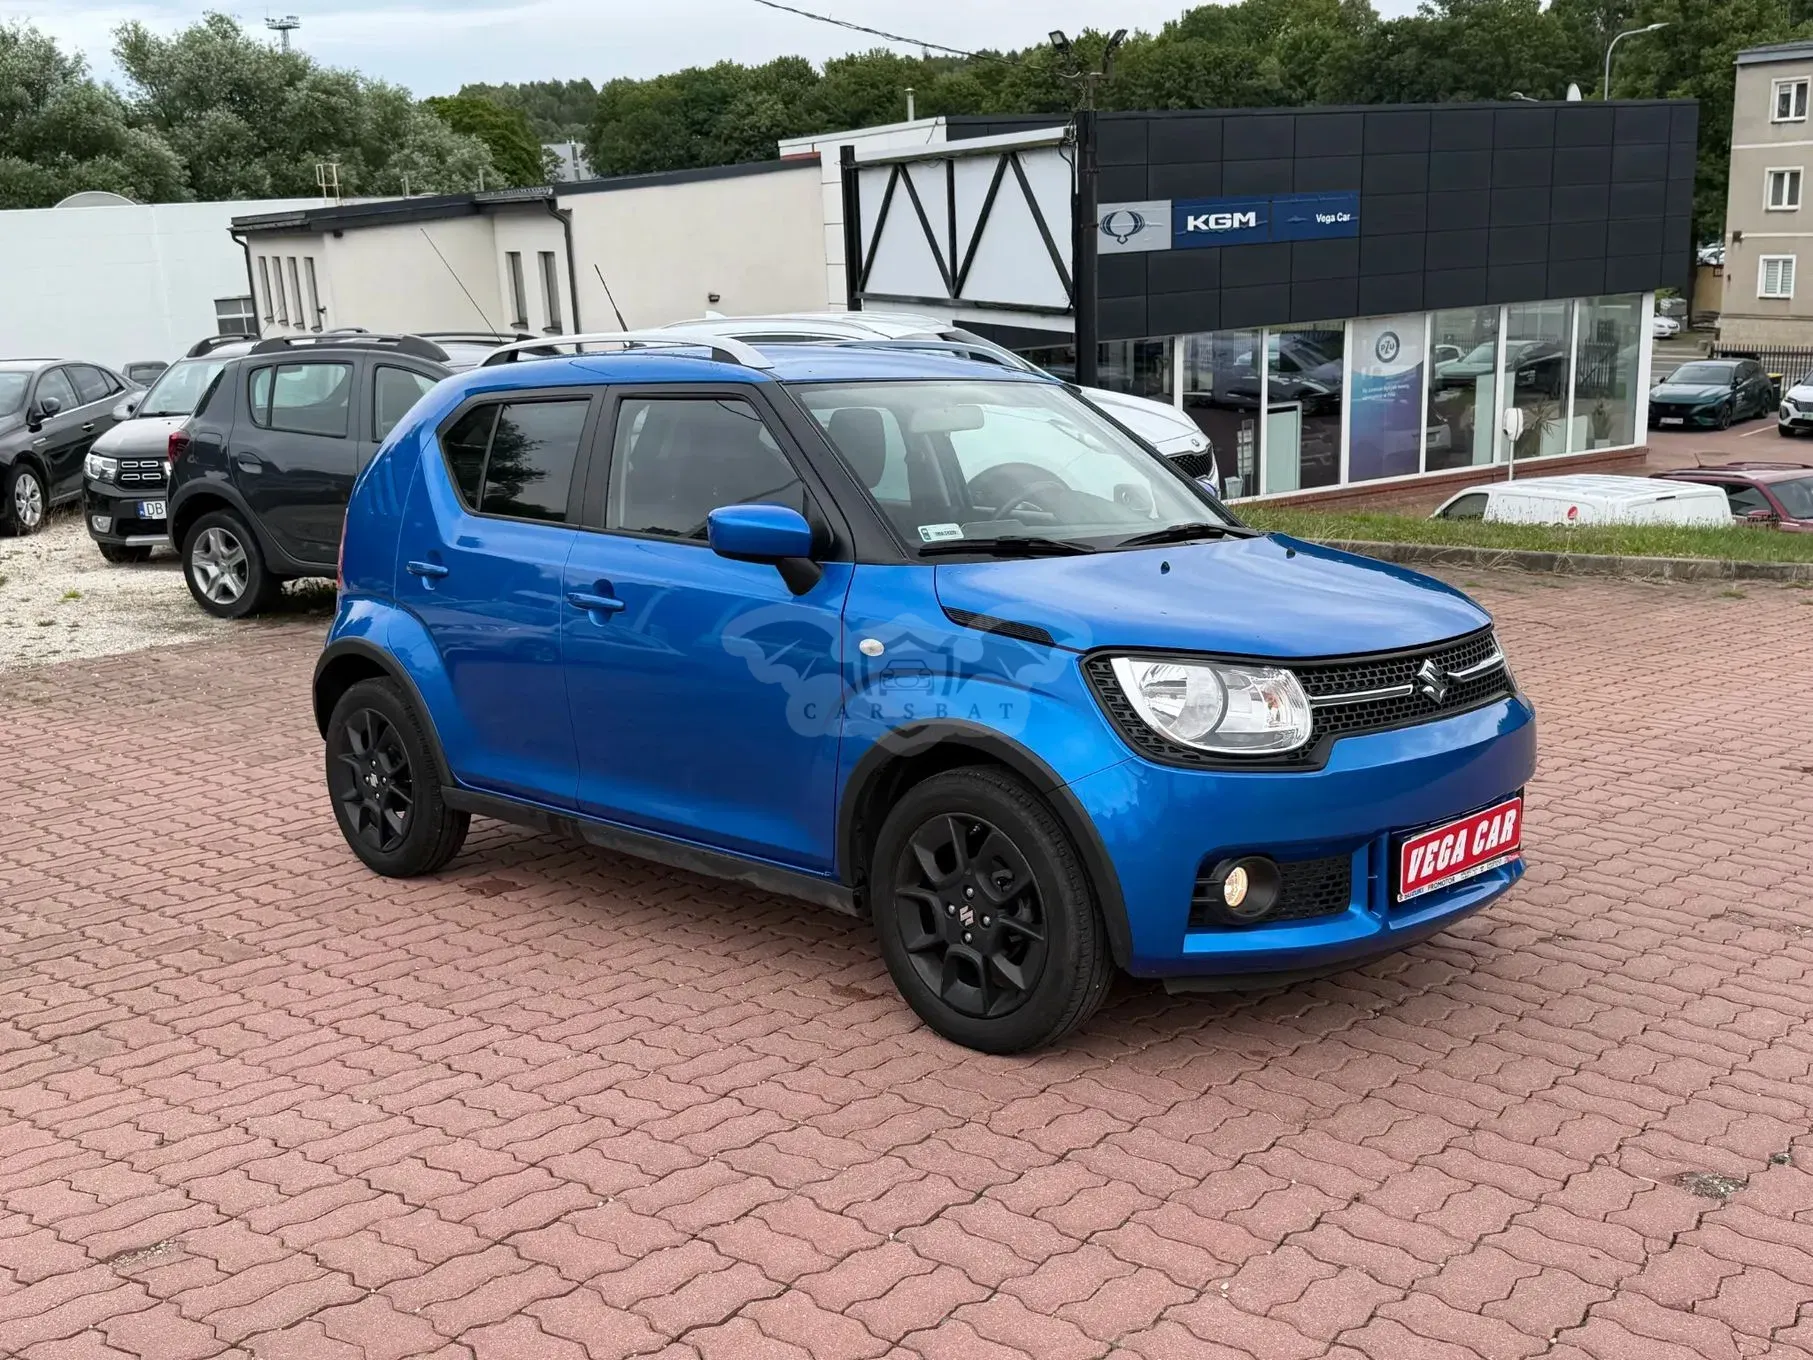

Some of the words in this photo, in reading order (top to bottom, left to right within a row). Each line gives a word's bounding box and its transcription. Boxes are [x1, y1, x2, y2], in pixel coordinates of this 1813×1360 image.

[1187, 211, 1257, 232] KGM
[1315, 213, 1336, 224] Vega
[1337, 212, 1351, 222] Car
[146, 502, 164, 516] DB
[1407, 828, 1468, 884] VEGA
[1472, 808, 1517, 856] CAR
